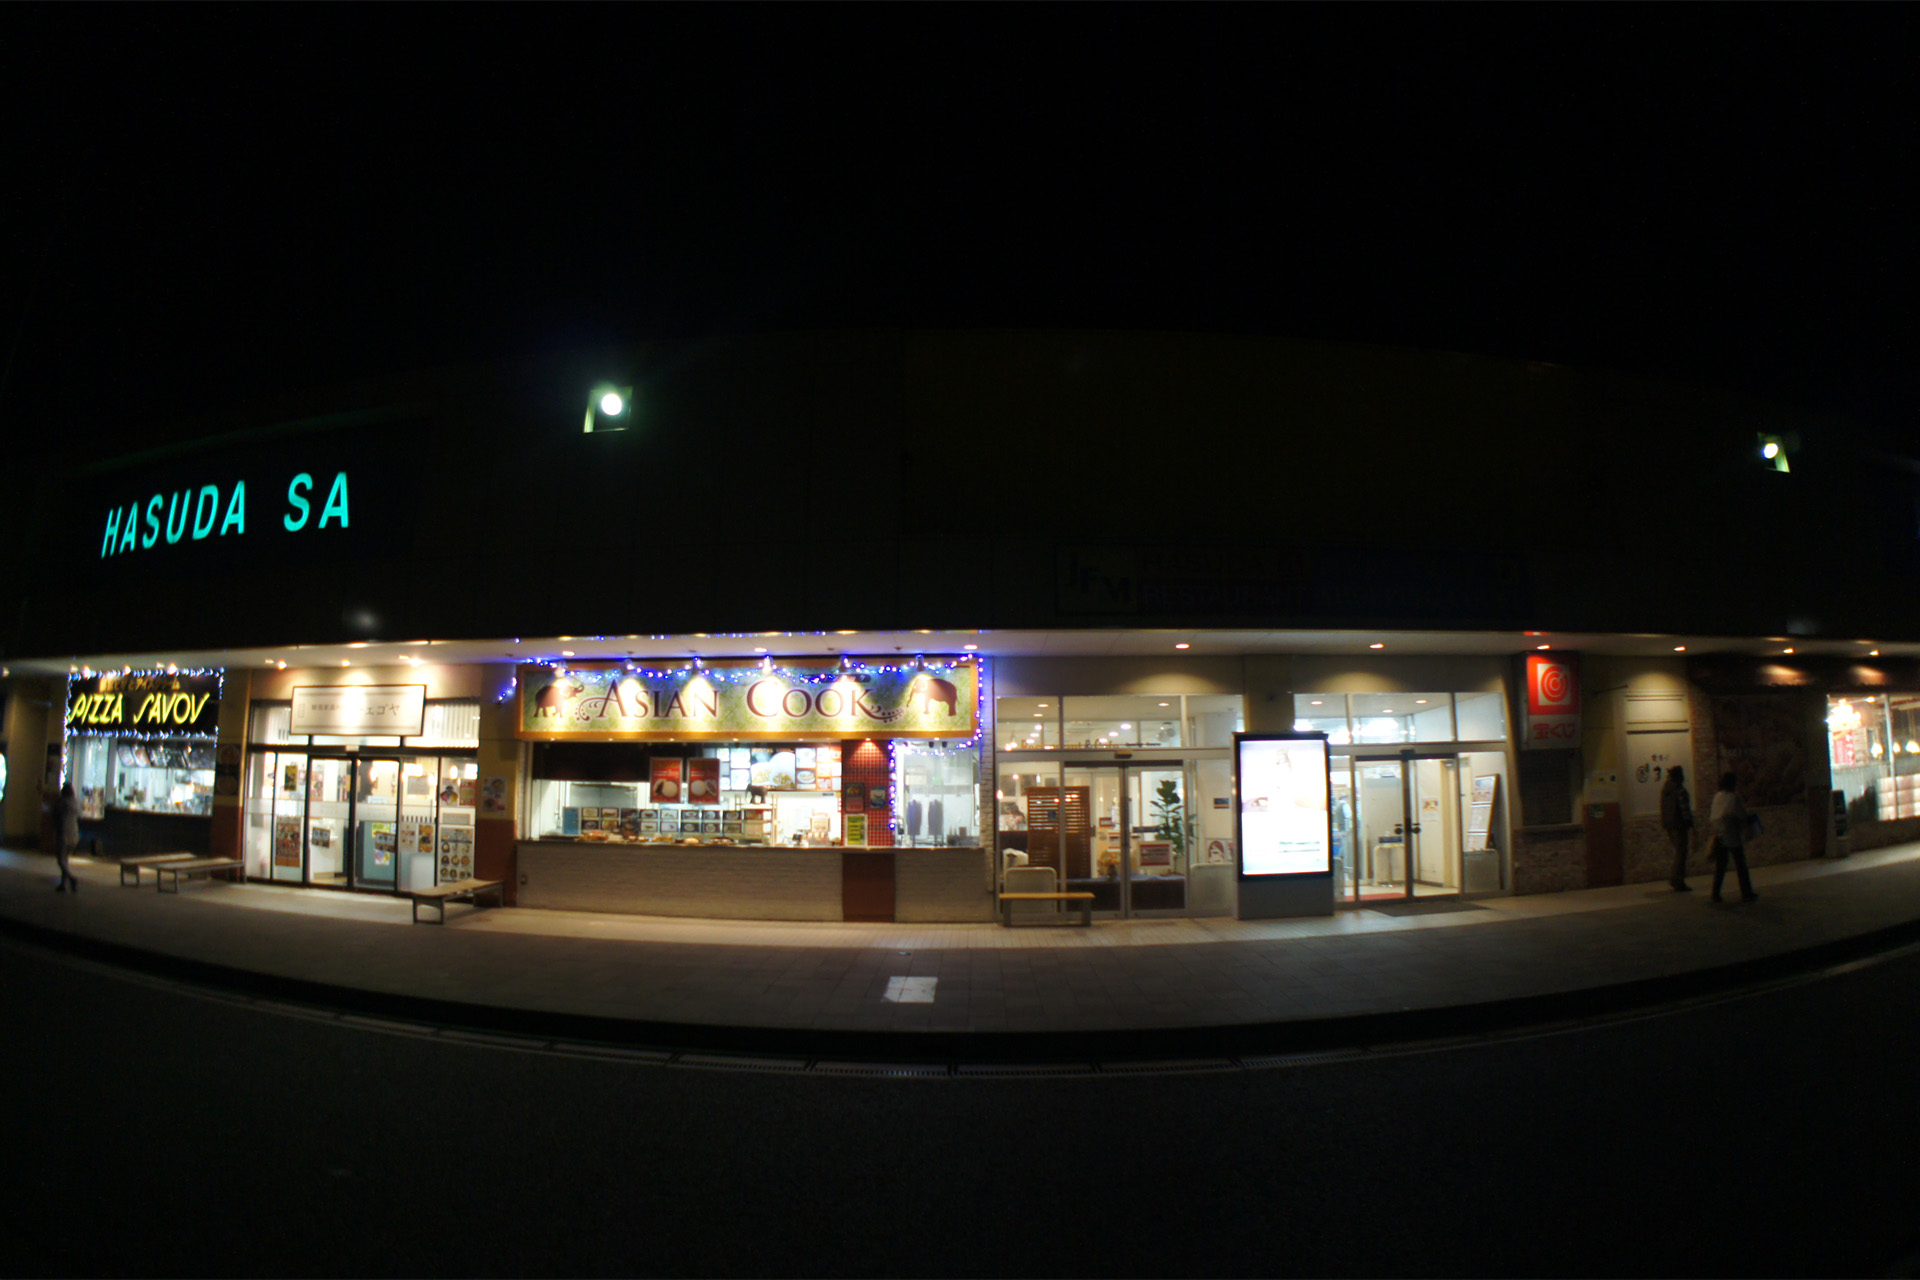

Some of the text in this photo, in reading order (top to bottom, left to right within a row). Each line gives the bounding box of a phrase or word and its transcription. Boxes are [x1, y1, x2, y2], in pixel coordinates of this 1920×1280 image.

[101, 472, 349, 559] HASUDA SA
[68, 692, 123, 725] PIZZA
[1533, 722, 1577, 740] 宝くじ
